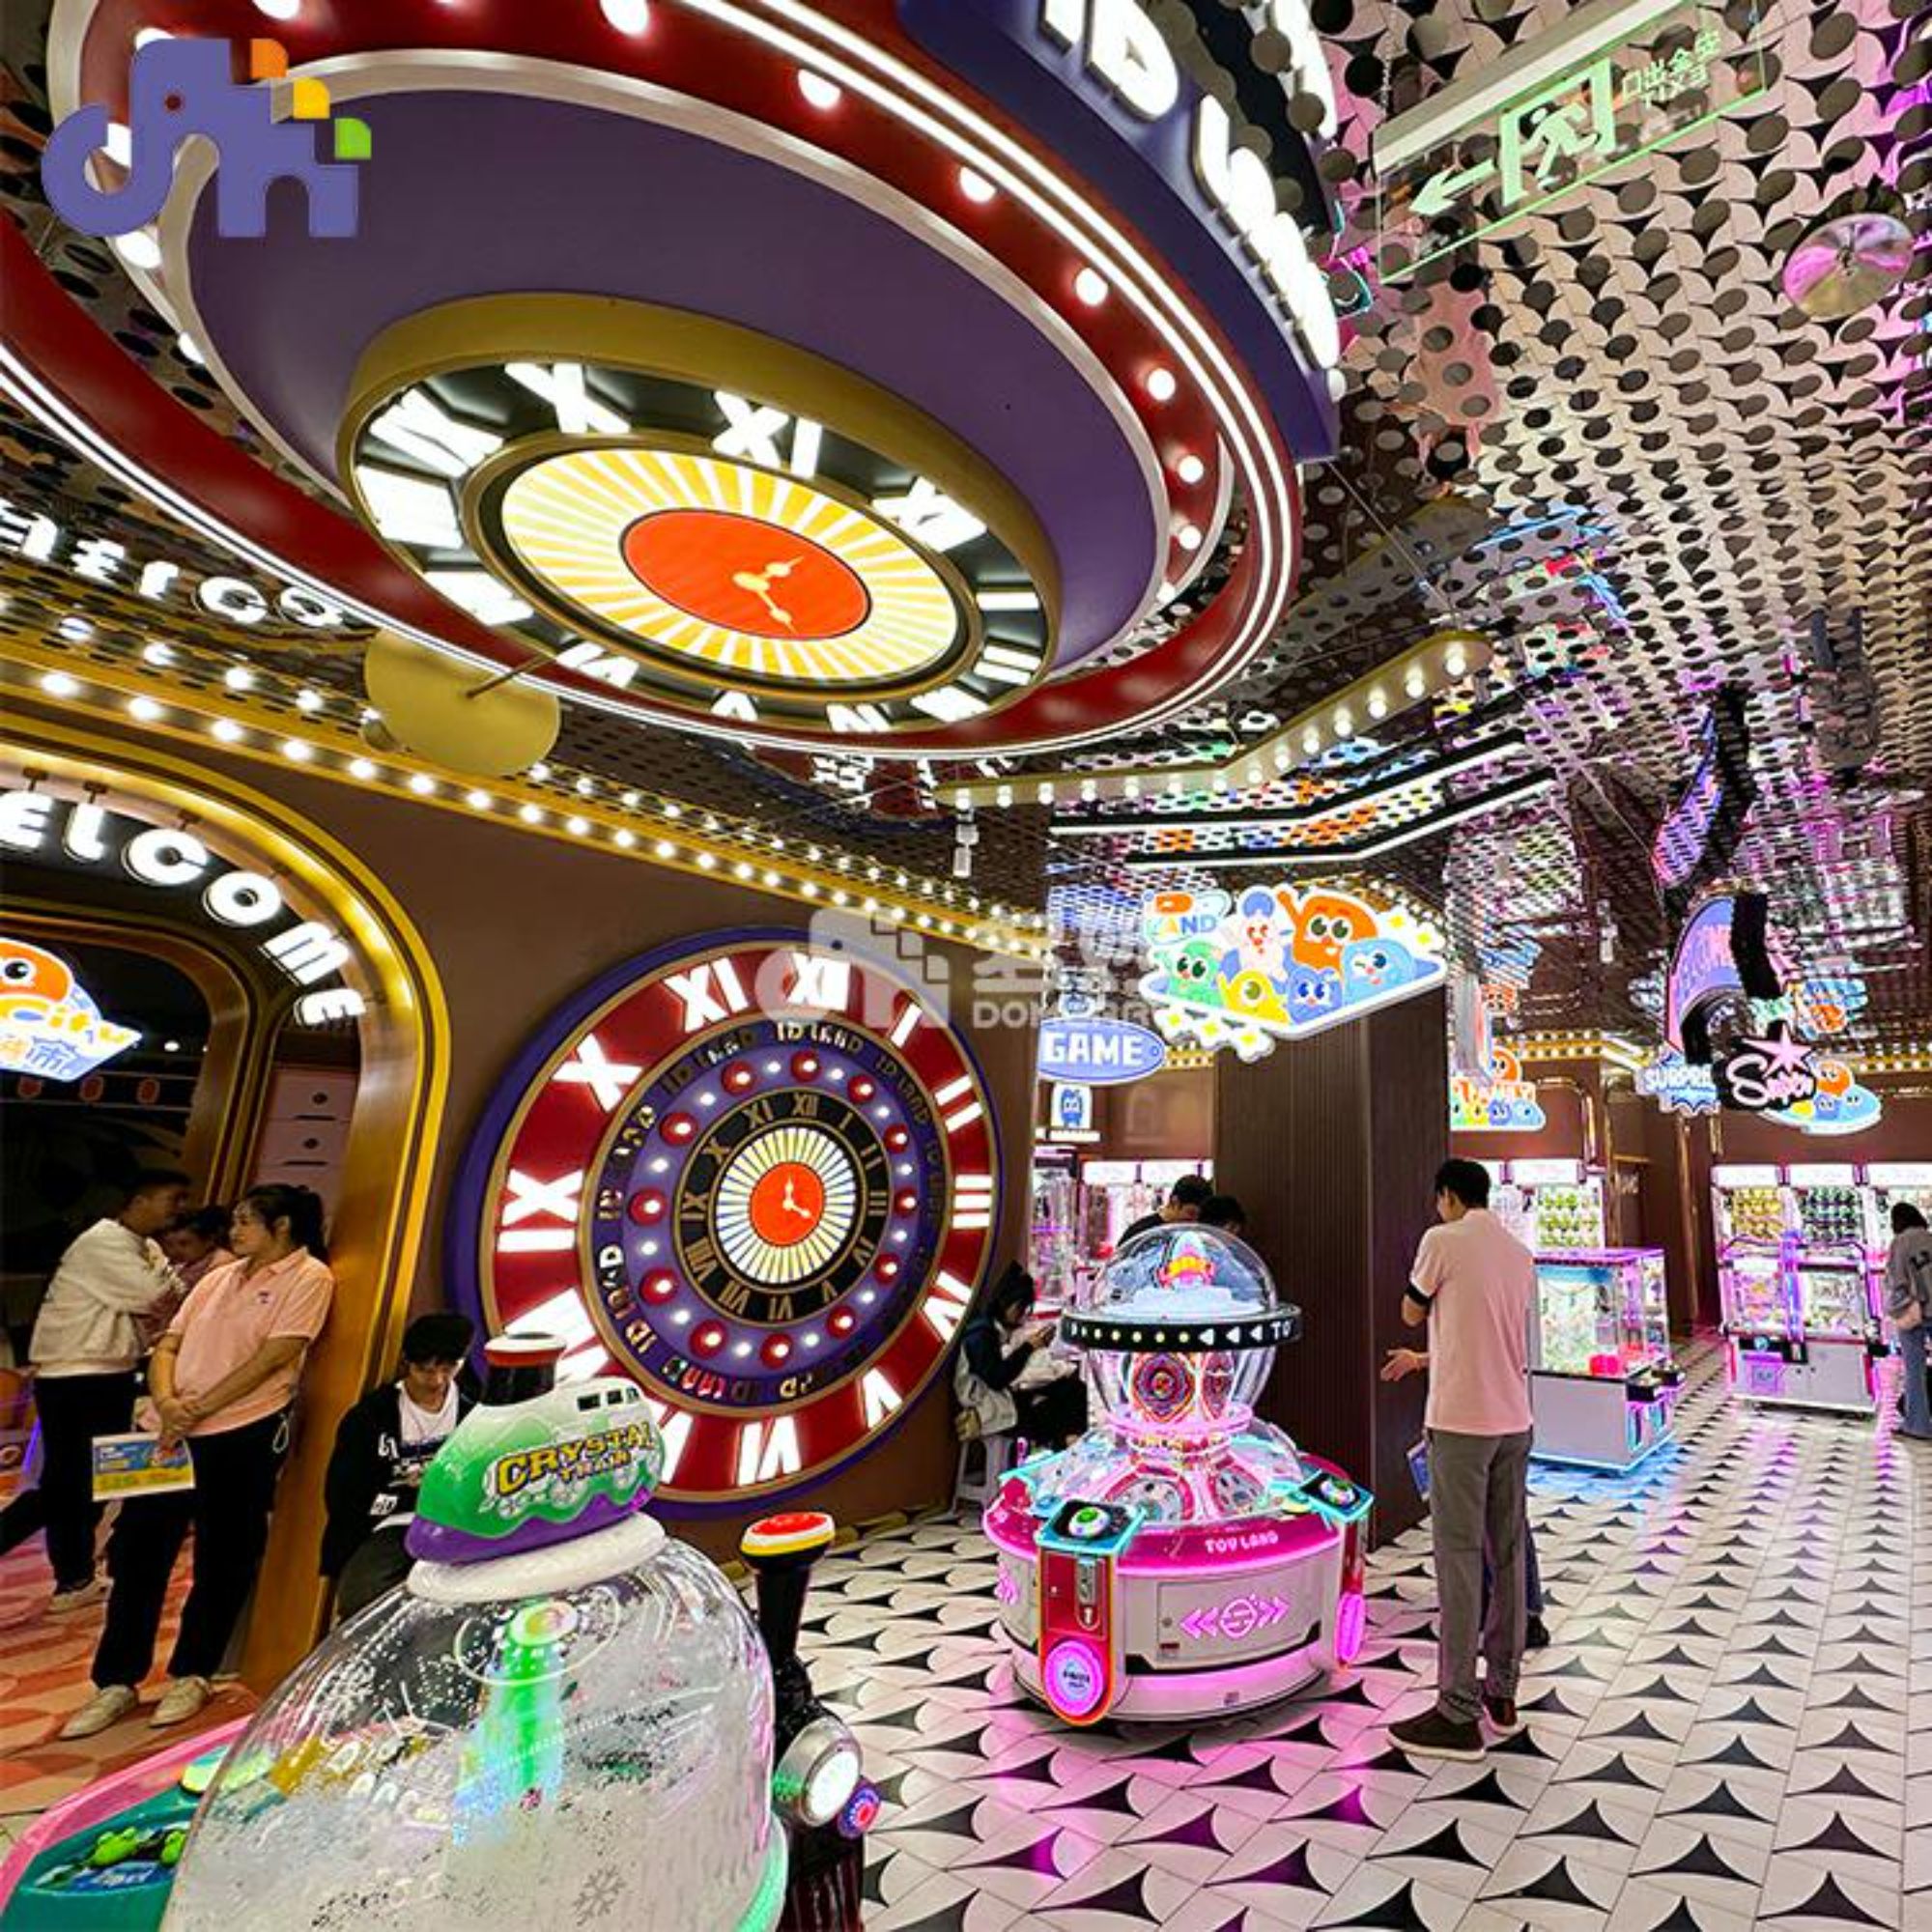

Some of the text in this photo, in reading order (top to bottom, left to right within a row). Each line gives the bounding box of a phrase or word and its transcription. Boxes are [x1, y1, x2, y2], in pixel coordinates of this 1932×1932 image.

[712, 389, 823, 478] XI
[664, 958, 749, 1033] XI
[552, 1033, 642, 1113] X
[1042, 1030, 1144, 1068] GAME
[933, 1074, 983, 1133] II
[495, 1169, 584, 1254] IX
[1204, 1536, 1237, 1554] TOY
